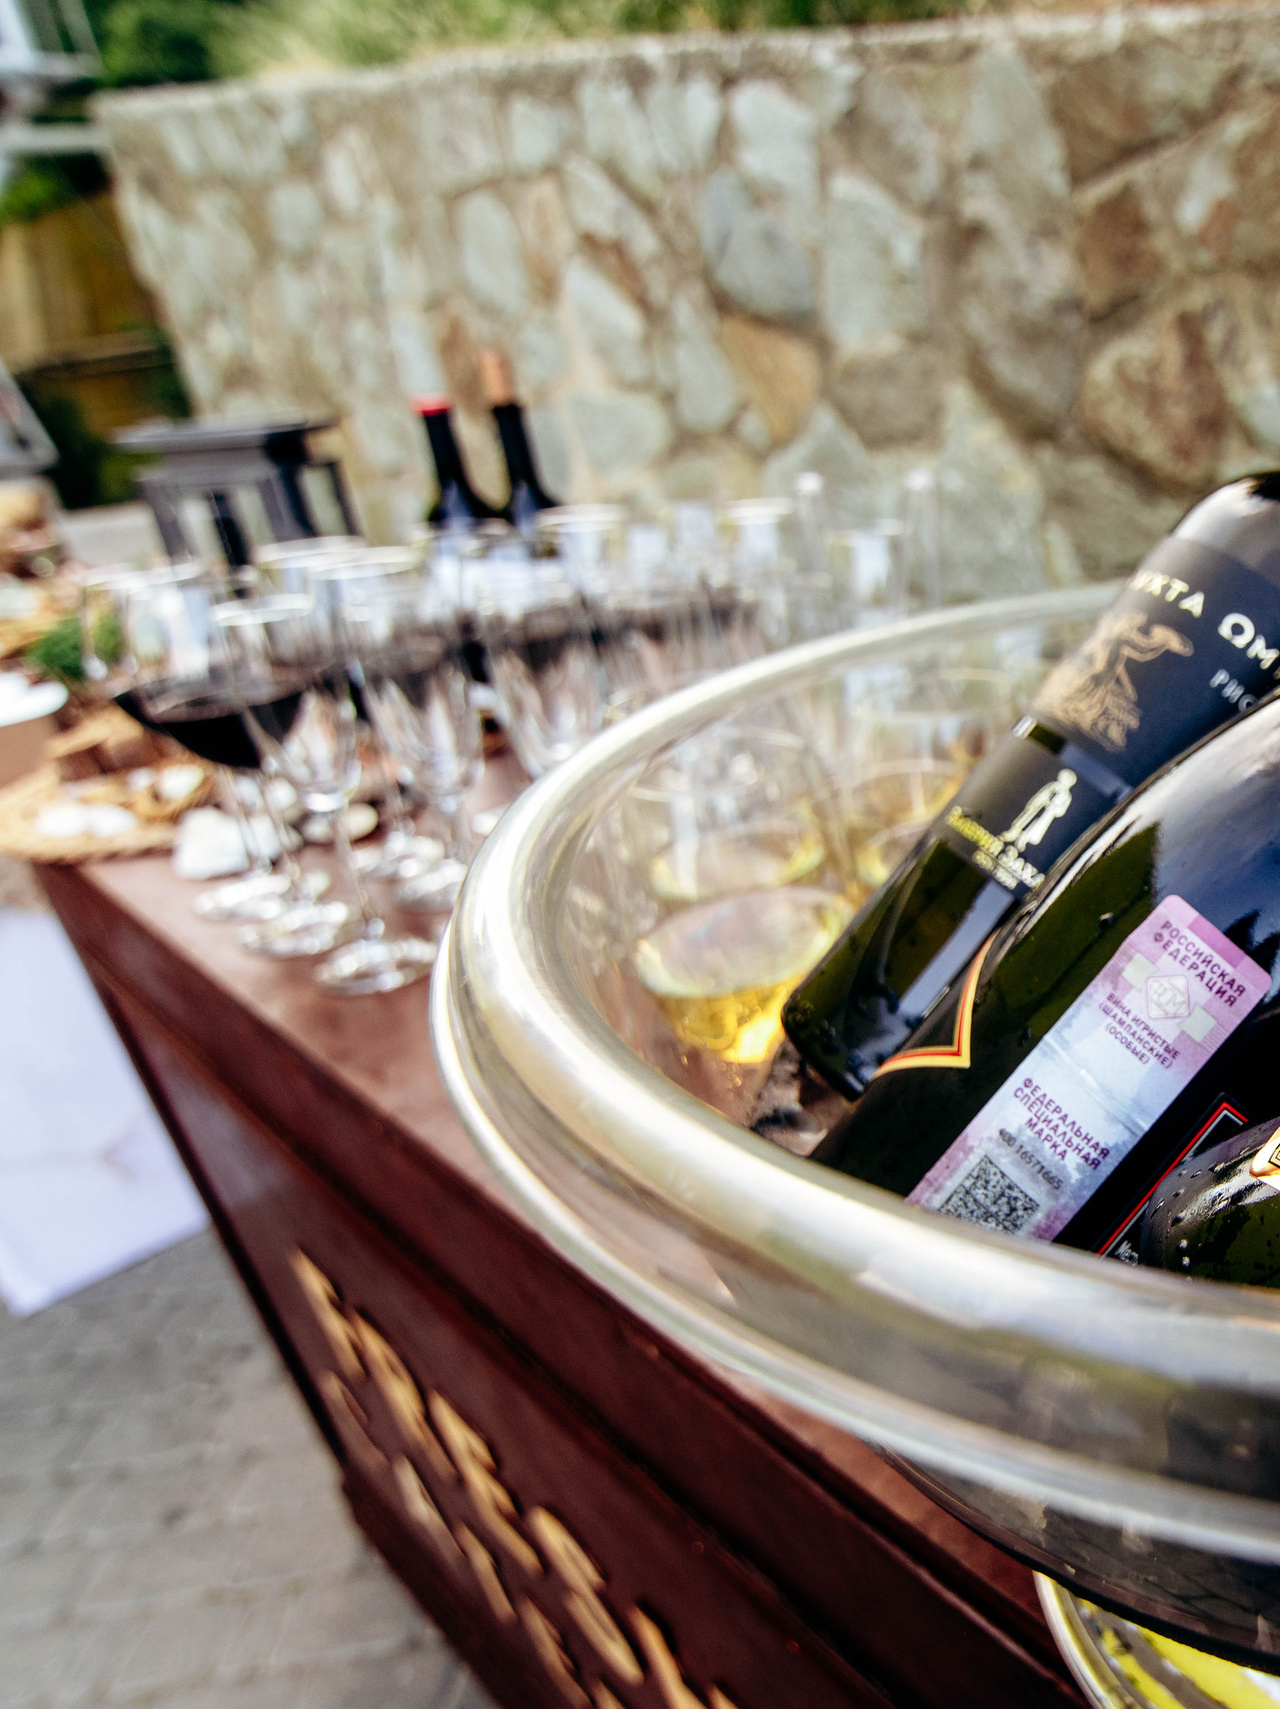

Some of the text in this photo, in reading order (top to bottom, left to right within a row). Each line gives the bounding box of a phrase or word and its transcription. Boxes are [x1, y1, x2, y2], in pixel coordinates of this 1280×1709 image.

[1153, 931, 1238, 1008] ФЕДЕРАЦИЯ
[1160, 920, 1247, 997] РОССИЙСКАЯ
[1098, 1001, 1175, 1070] (ШАМПАНСКИЕ)
[1105, 1021, 1152, 1065] (ОСОБЫЕ)
[1106, 992, 1132, 1017] ВИНА
[1131, 1014, 1182, 1061] ИГРИСТЫЕ
[1013, 1086, 1102, 1171] СПЕЦИАЛЬНАЯ
[1022, 1077, 1111, 1161] ФЕДЕРАЛЬНАЯ
[1024, 1116, 1068, 1162] МАРКА
